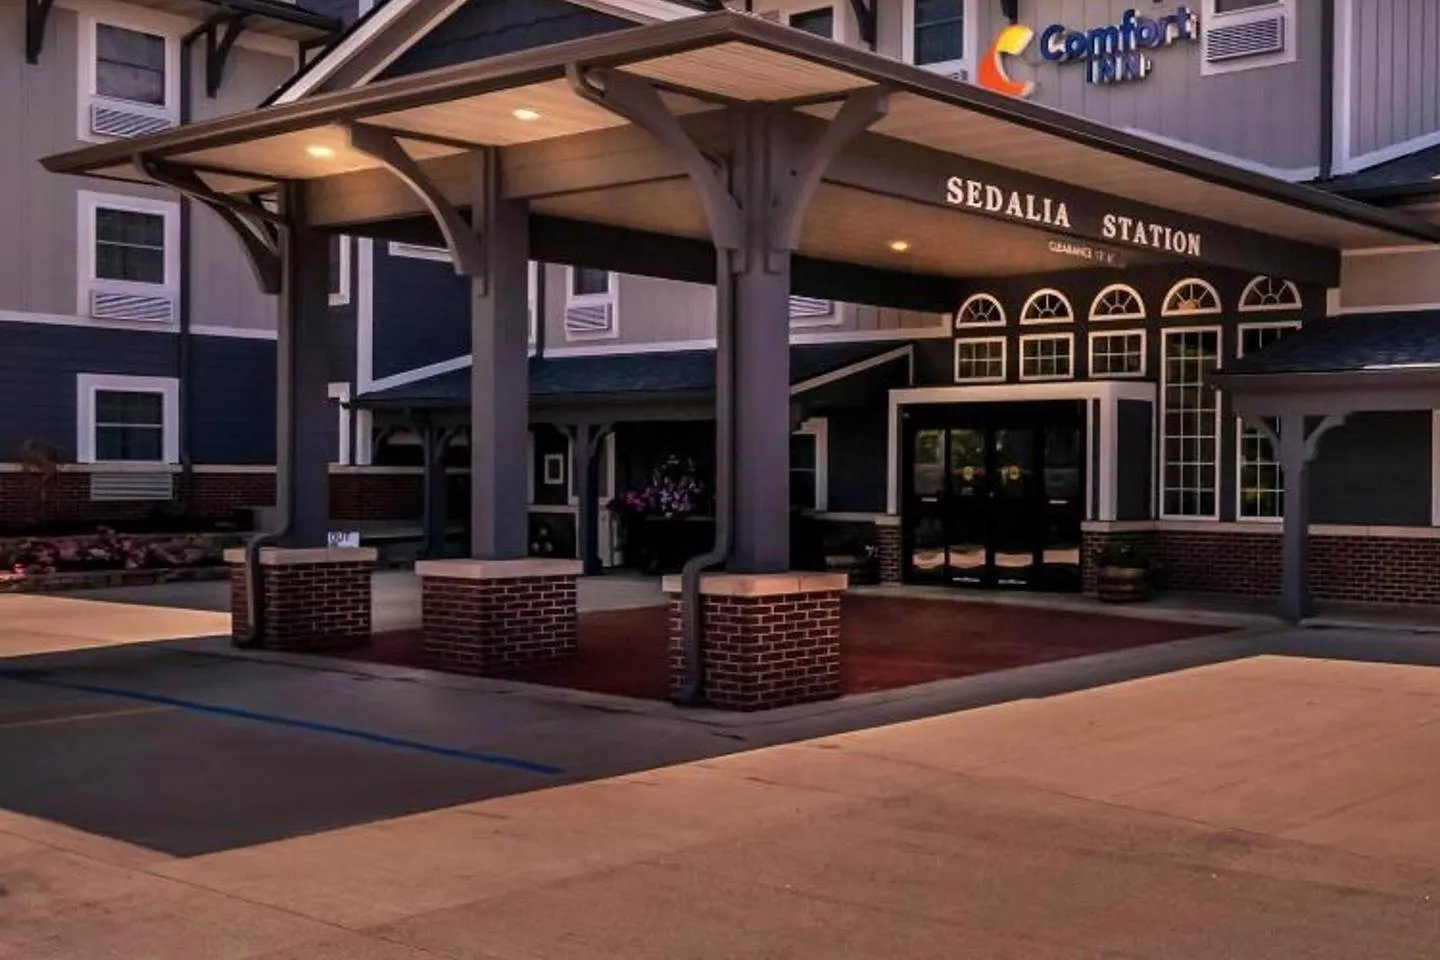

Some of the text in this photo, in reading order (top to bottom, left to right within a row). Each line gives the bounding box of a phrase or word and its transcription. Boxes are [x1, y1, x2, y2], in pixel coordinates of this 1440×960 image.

[1040, 6, 1199, 60] Comfort
[946, 176, 1201, 257] SEDALIA STATION
